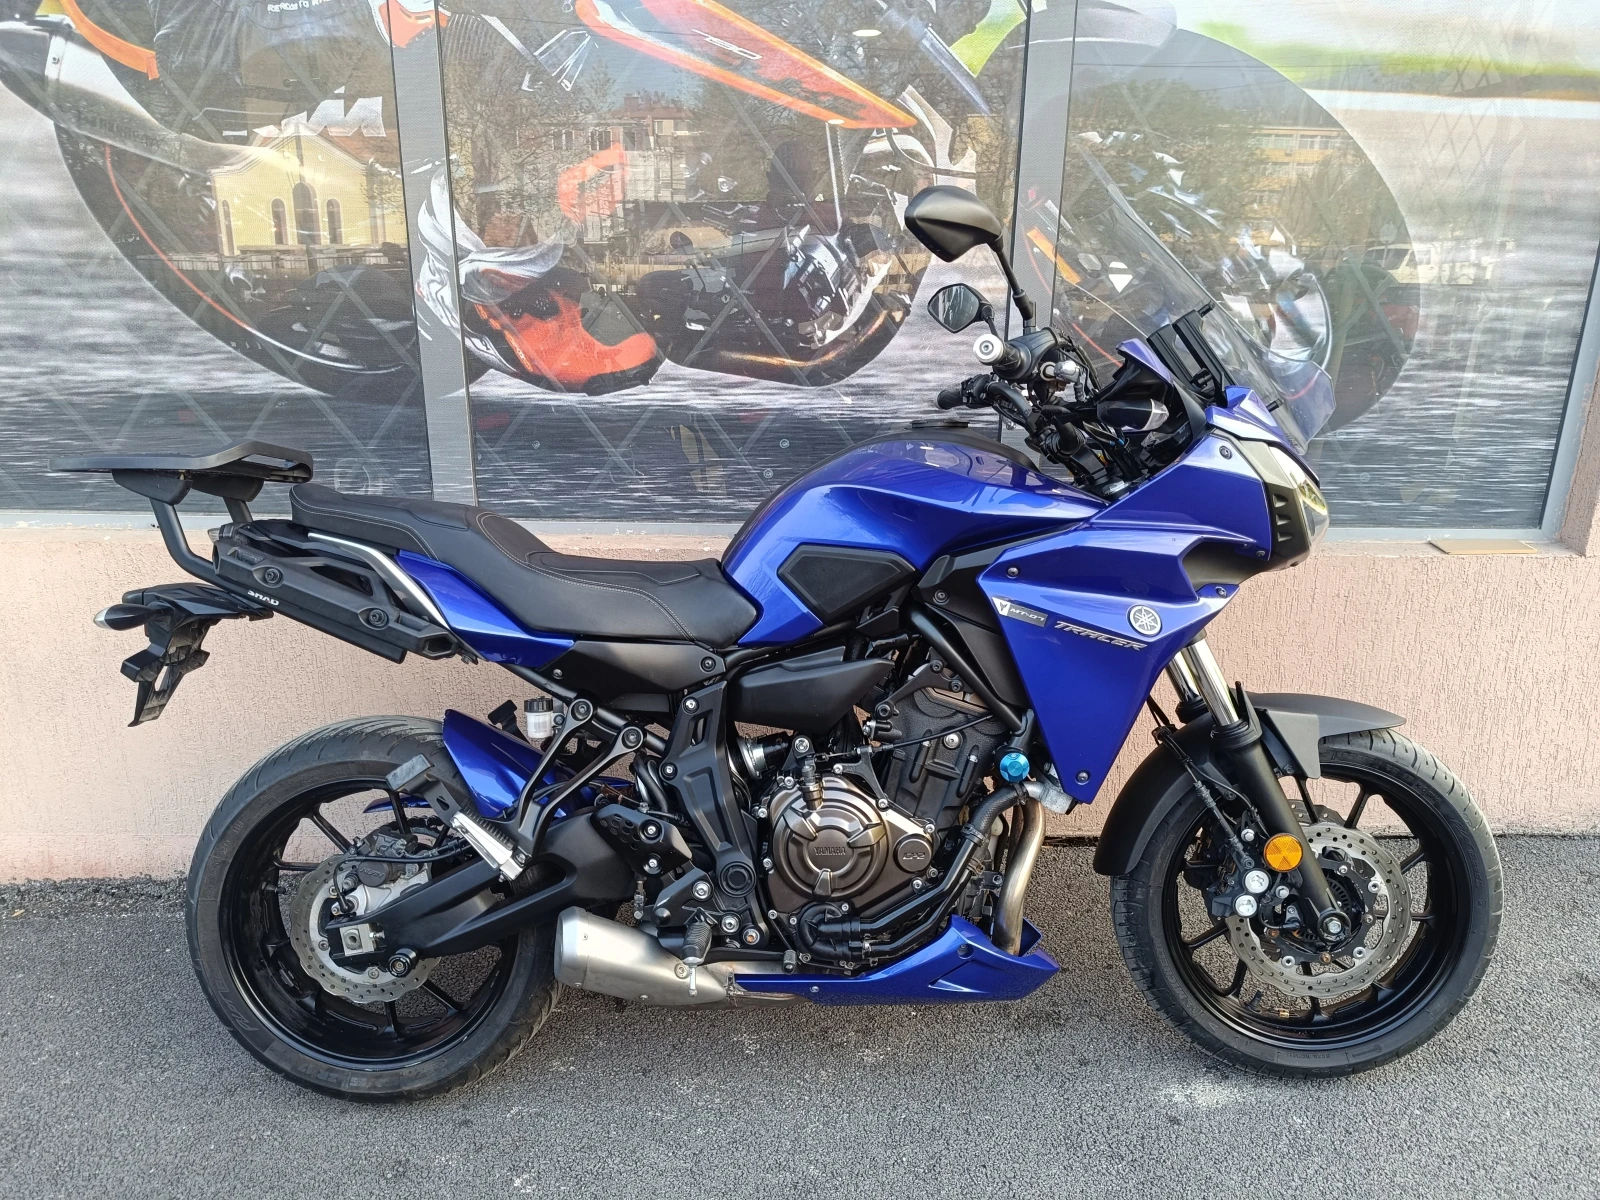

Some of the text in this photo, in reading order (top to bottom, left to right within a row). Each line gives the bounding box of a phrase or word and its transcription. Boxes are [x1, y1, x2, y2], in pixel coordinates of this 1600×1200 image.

[1010, 608, 1044, 621] MT-07
[1054, 621, 1147, 651] TRACER
[814, 846, 846, 856] YAMAHA
